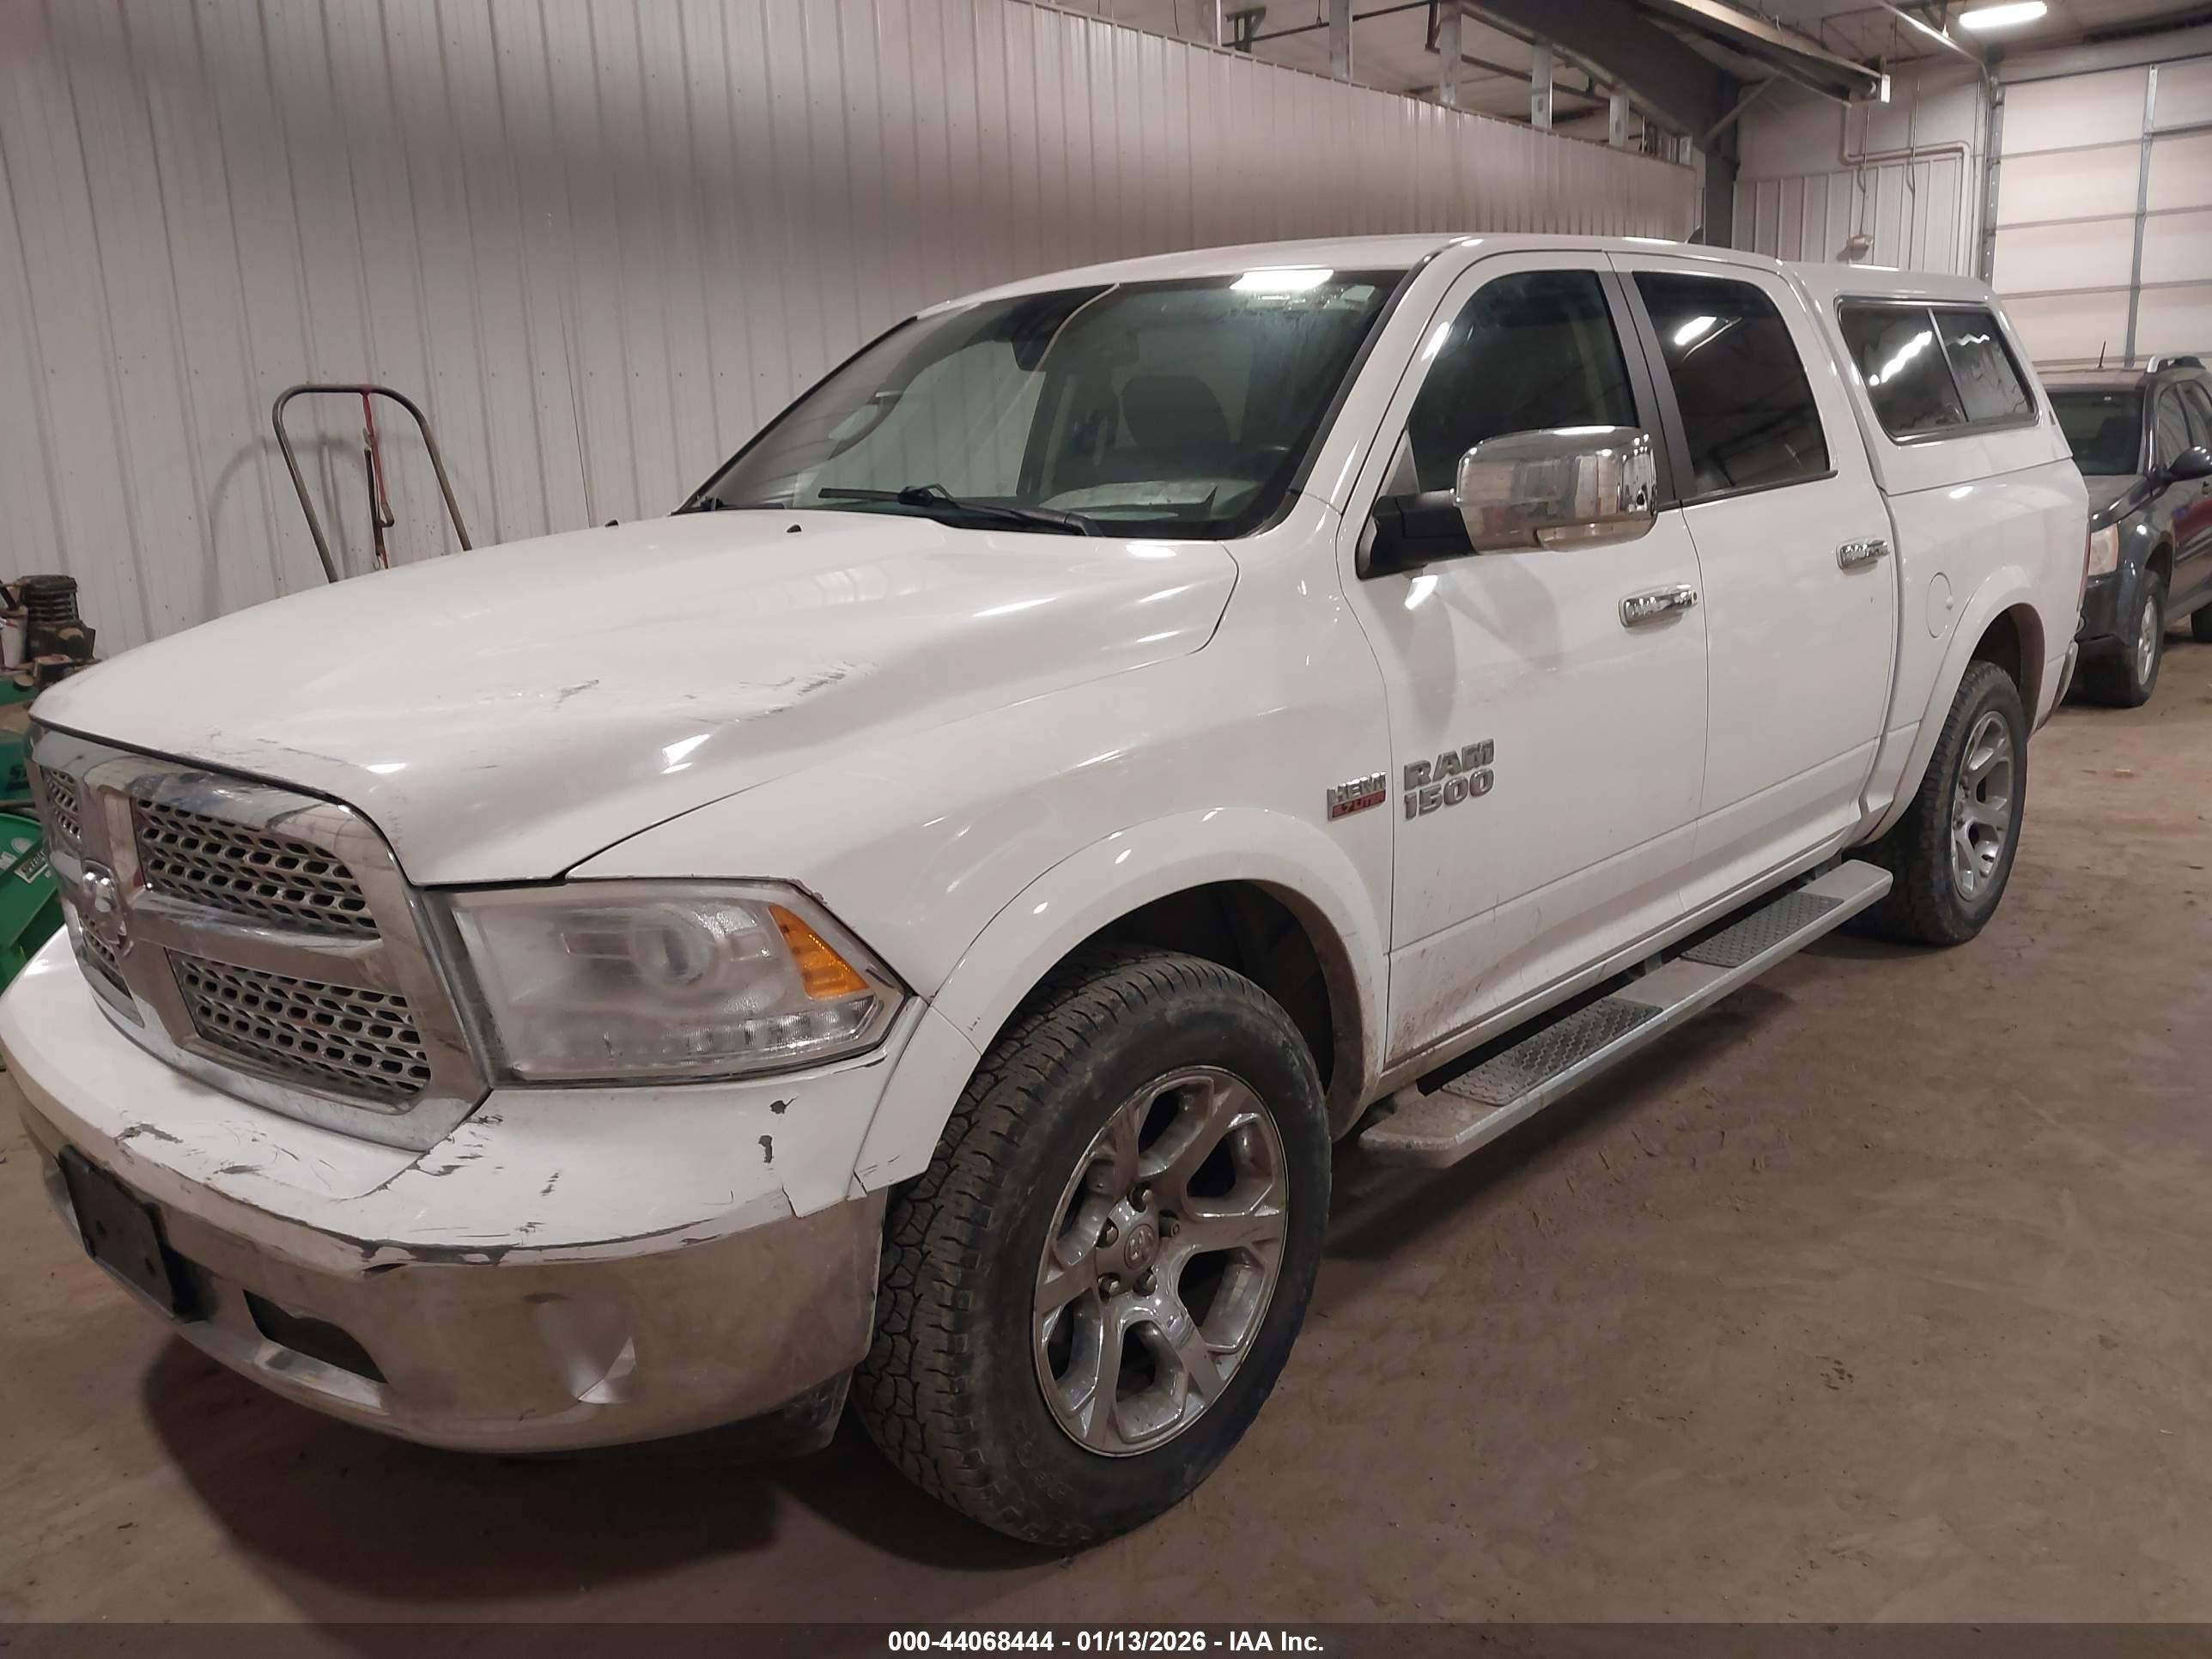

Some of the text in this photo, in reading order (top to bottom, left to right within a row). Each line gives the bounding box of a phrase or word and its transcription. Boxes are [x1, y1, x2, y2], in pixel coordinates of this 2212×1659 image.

[1328, 771, 1386, 805] HEMI
[1404, 738, 1495, 791] RAM
[1404, 769, 1495, 820] 1500
